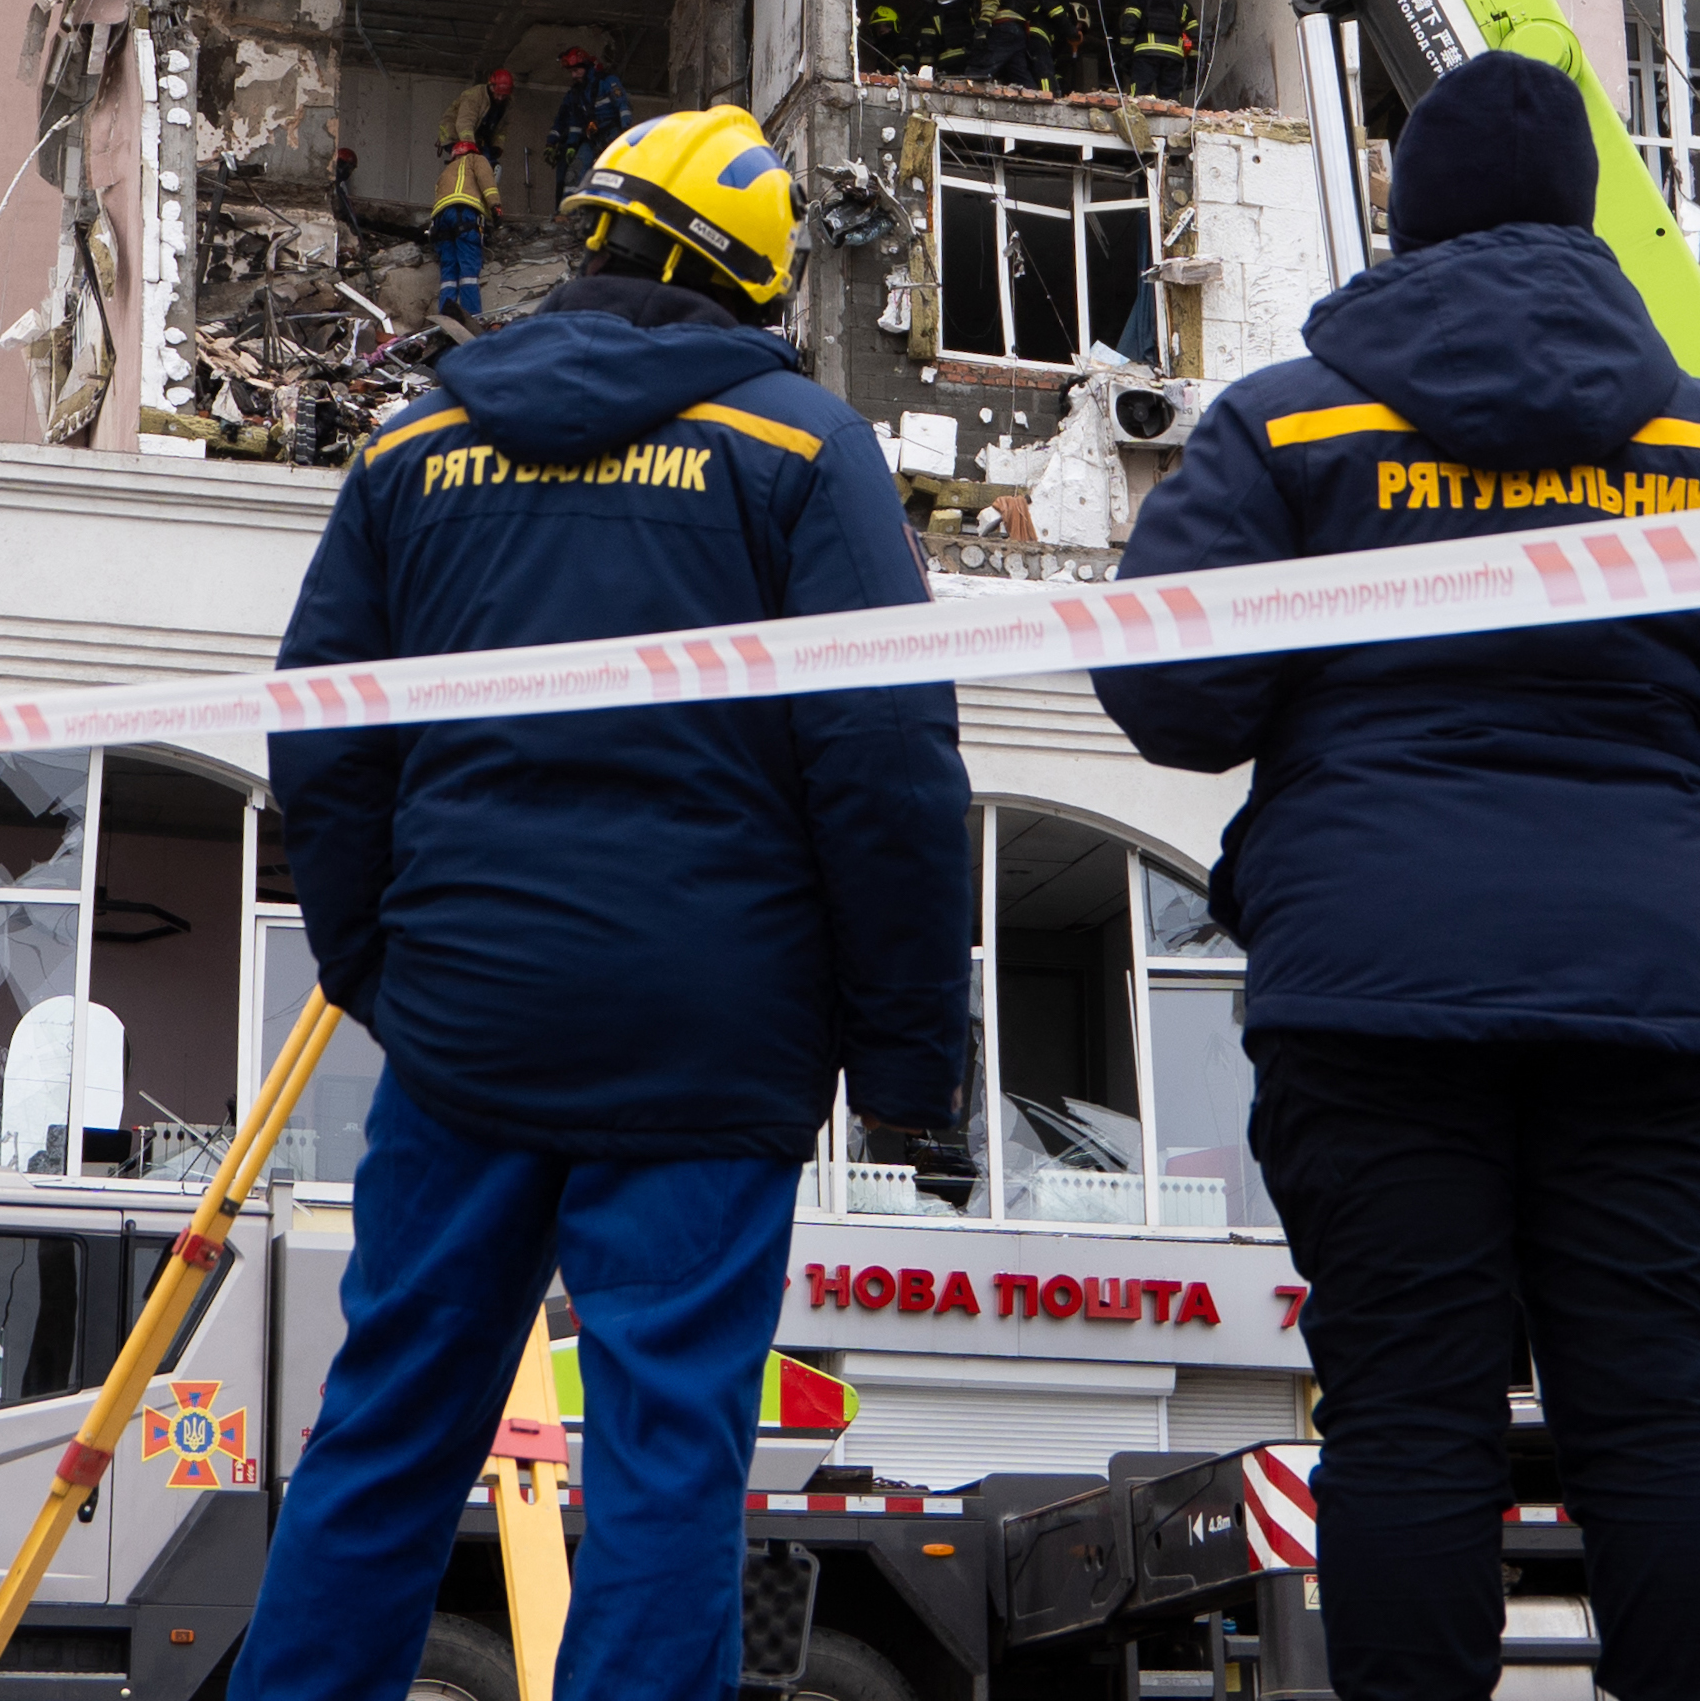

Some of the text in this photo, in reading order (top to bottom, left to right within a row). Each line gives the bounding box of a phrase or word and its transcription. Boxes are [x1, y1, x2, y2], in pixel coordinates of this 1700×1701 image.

[1410, 21, 1431, 52] ПОД
[805, 1262, 981, 1315] НОВА
[993, 1271, 1222, 1325] ПОШТА
[1208, 1514, 1232, 1534] 4.8m
